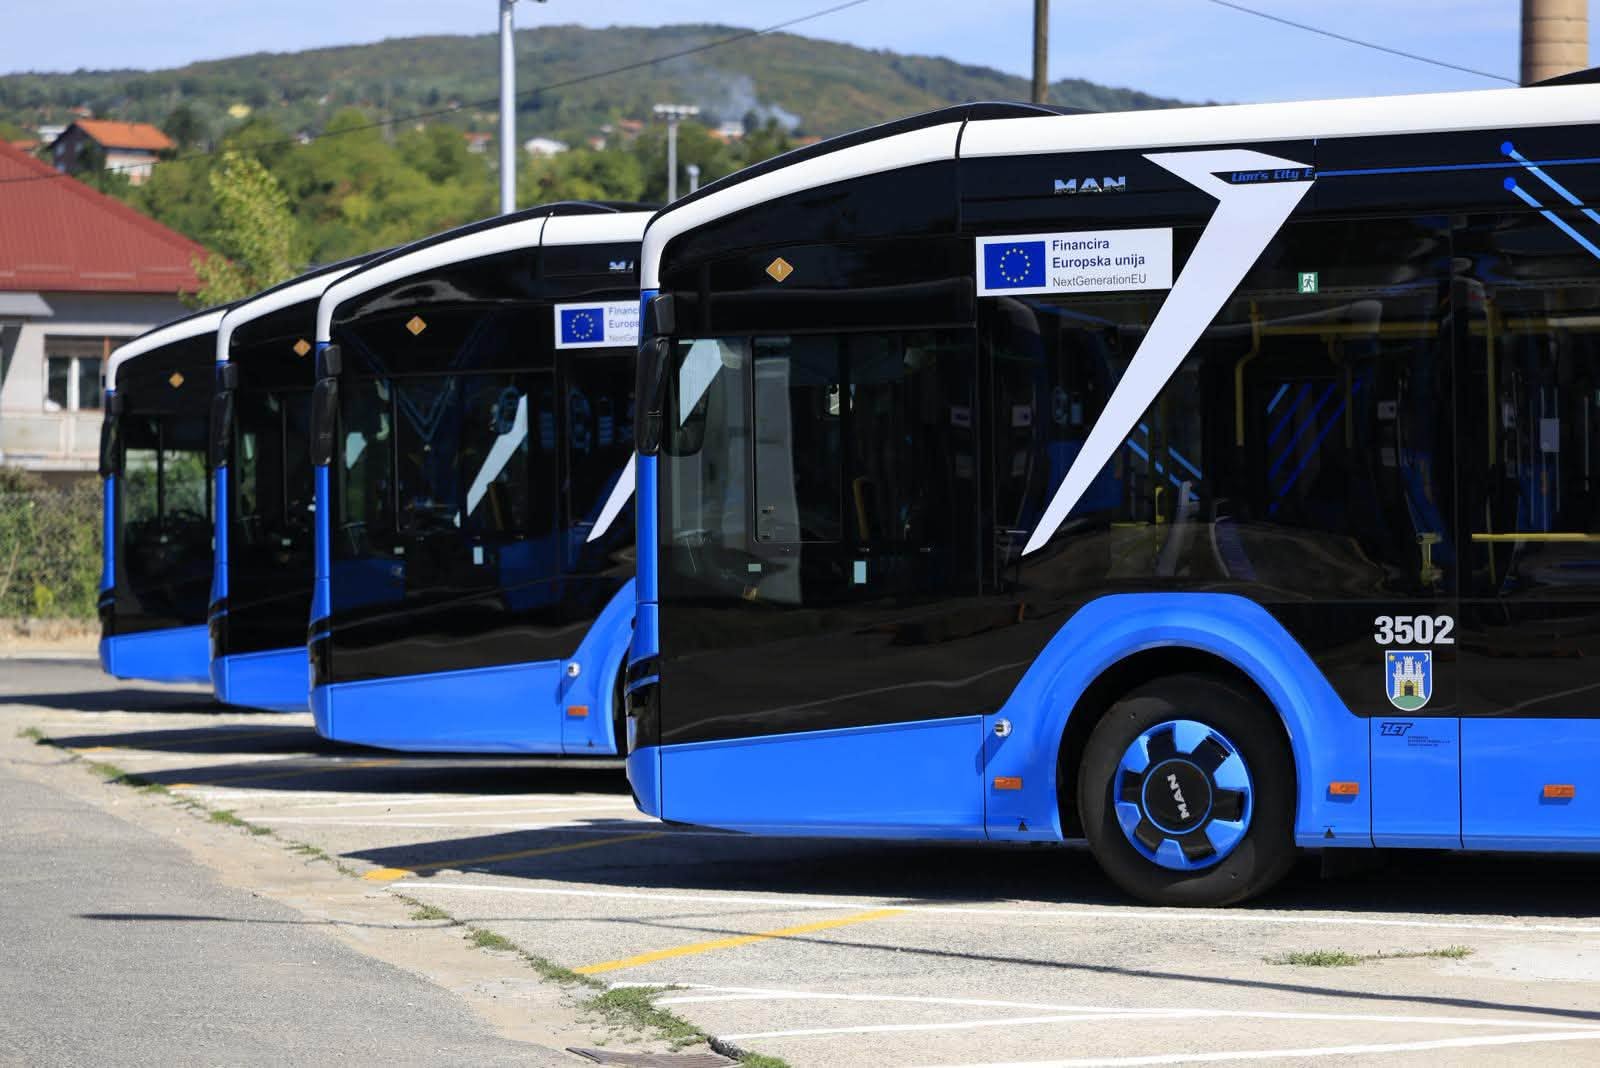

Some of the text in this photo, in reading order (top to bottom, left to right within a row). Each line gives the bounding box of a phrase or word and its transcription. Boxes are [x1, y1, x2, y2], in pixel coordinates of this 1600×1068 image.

[1303, 167, 1313, 178] E
[1054, 176, 1126, 194] MAN
[1052, 238, 1110, 251] Financira
[1052, 254, 1145, 270] Europska unija
[1052, 273, 1147, 287] NextGenerationEU
[1374, 615, 1455, 645] 3502
[1380, 722, 1414, 737] ZET
[1167, 773, 1191, 820] MAN
